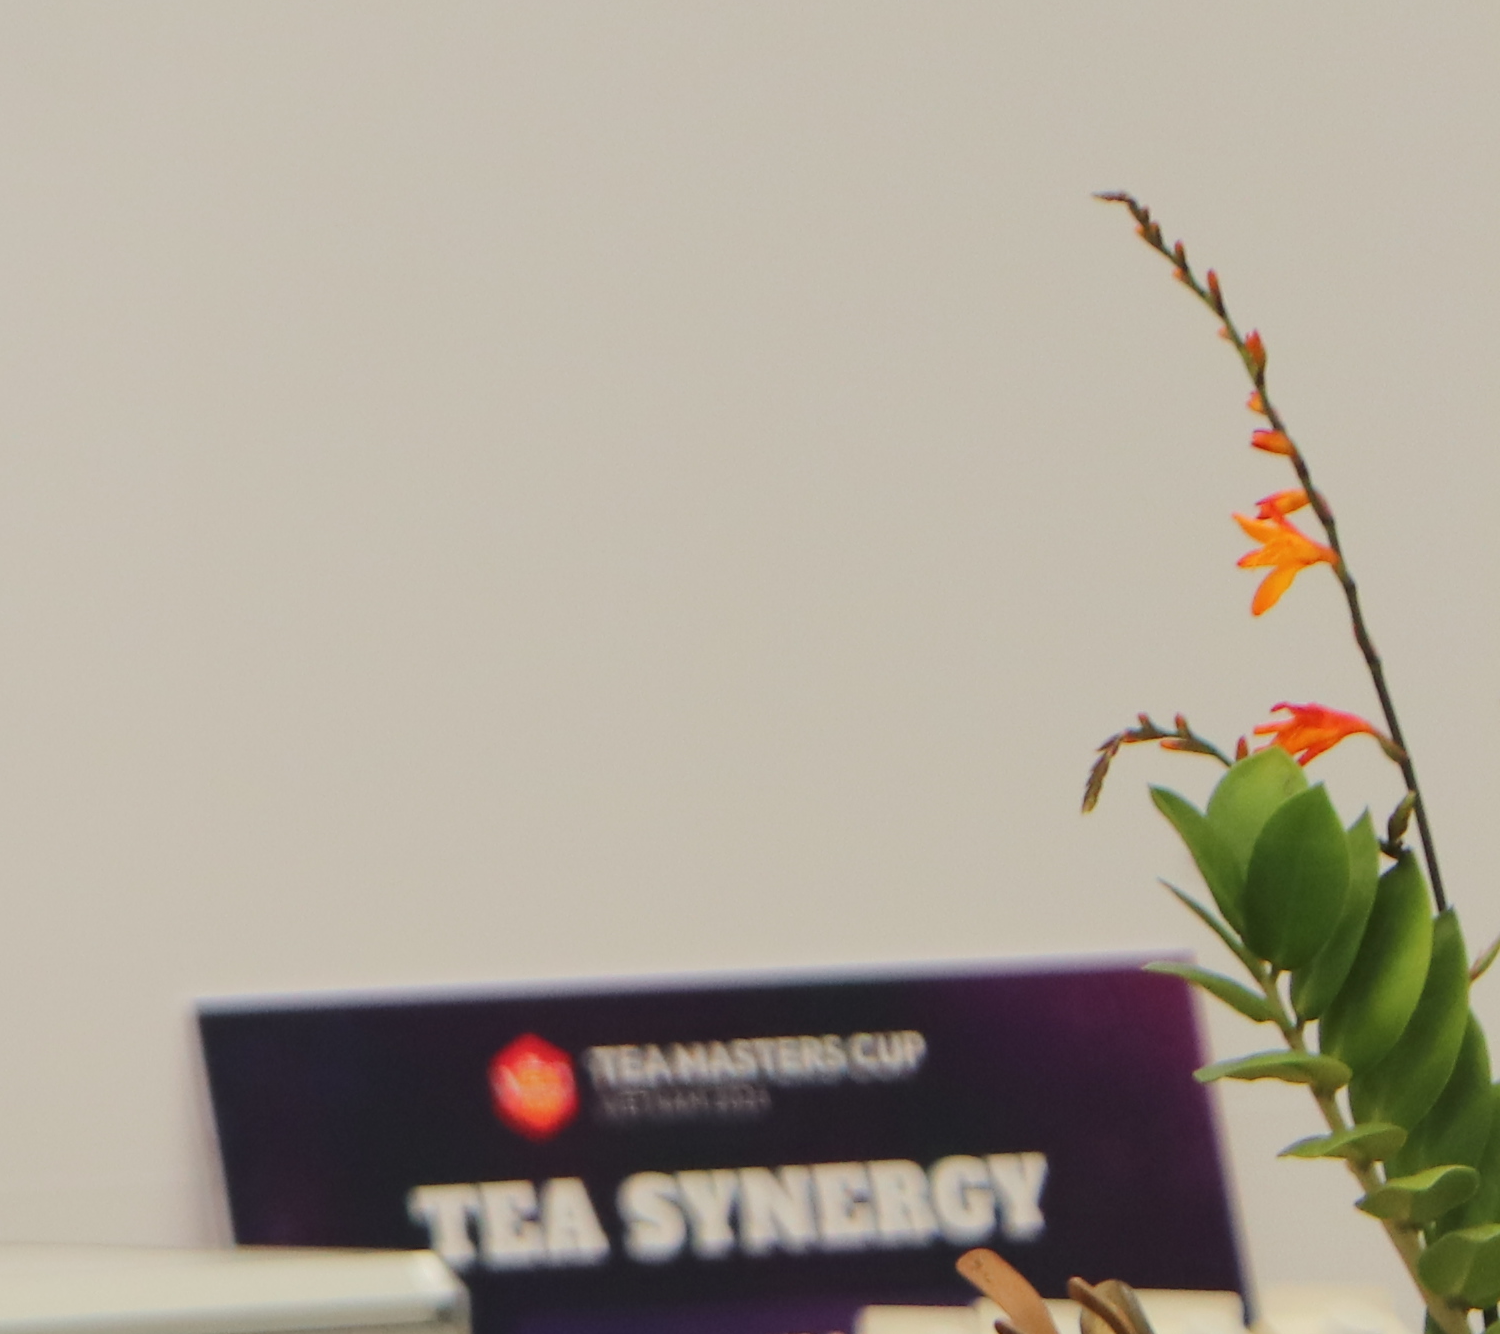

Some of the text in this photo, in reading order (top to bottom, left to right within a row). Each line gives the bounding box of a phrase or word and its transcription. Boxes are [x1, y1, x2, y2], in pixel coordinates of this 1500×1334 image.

[585, 1044, 671, 1087] TEA
[672, 1034, 846, 1086] MASTERS
[847, 1030, 927, 1080] CUP
[408, 1152, 1048, 1269] TEA SYNERGY
